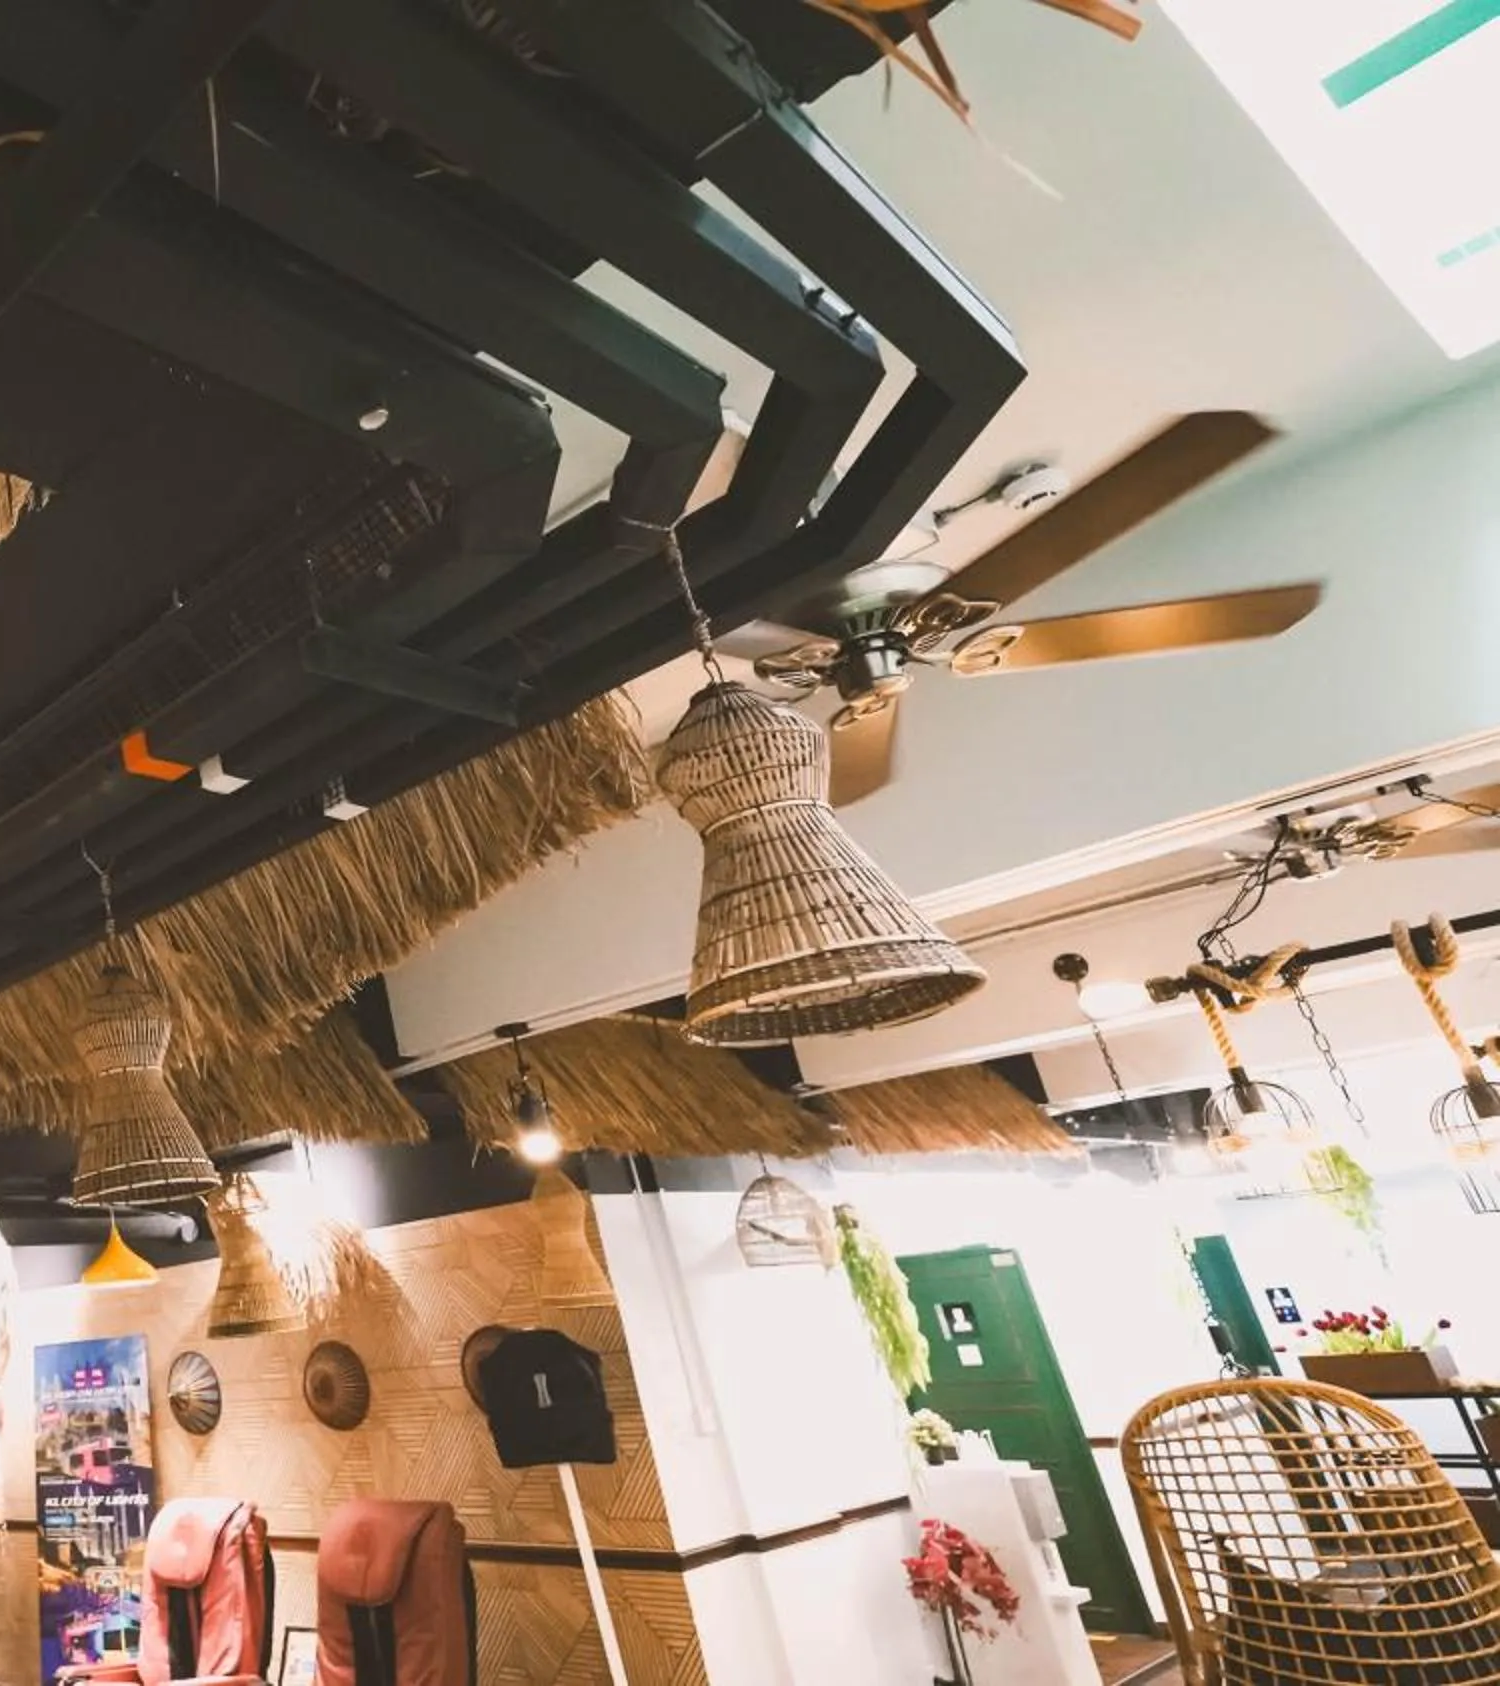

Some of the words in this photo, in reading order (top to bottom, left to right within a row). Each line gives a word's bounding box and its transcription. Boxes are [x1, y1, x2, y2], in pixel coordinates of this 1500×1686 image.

[61, 1496, 85, 1507] CITY
[87, 1495, 105, 1506] OF
[105, 1494, 149, 1506] LIGHTS
